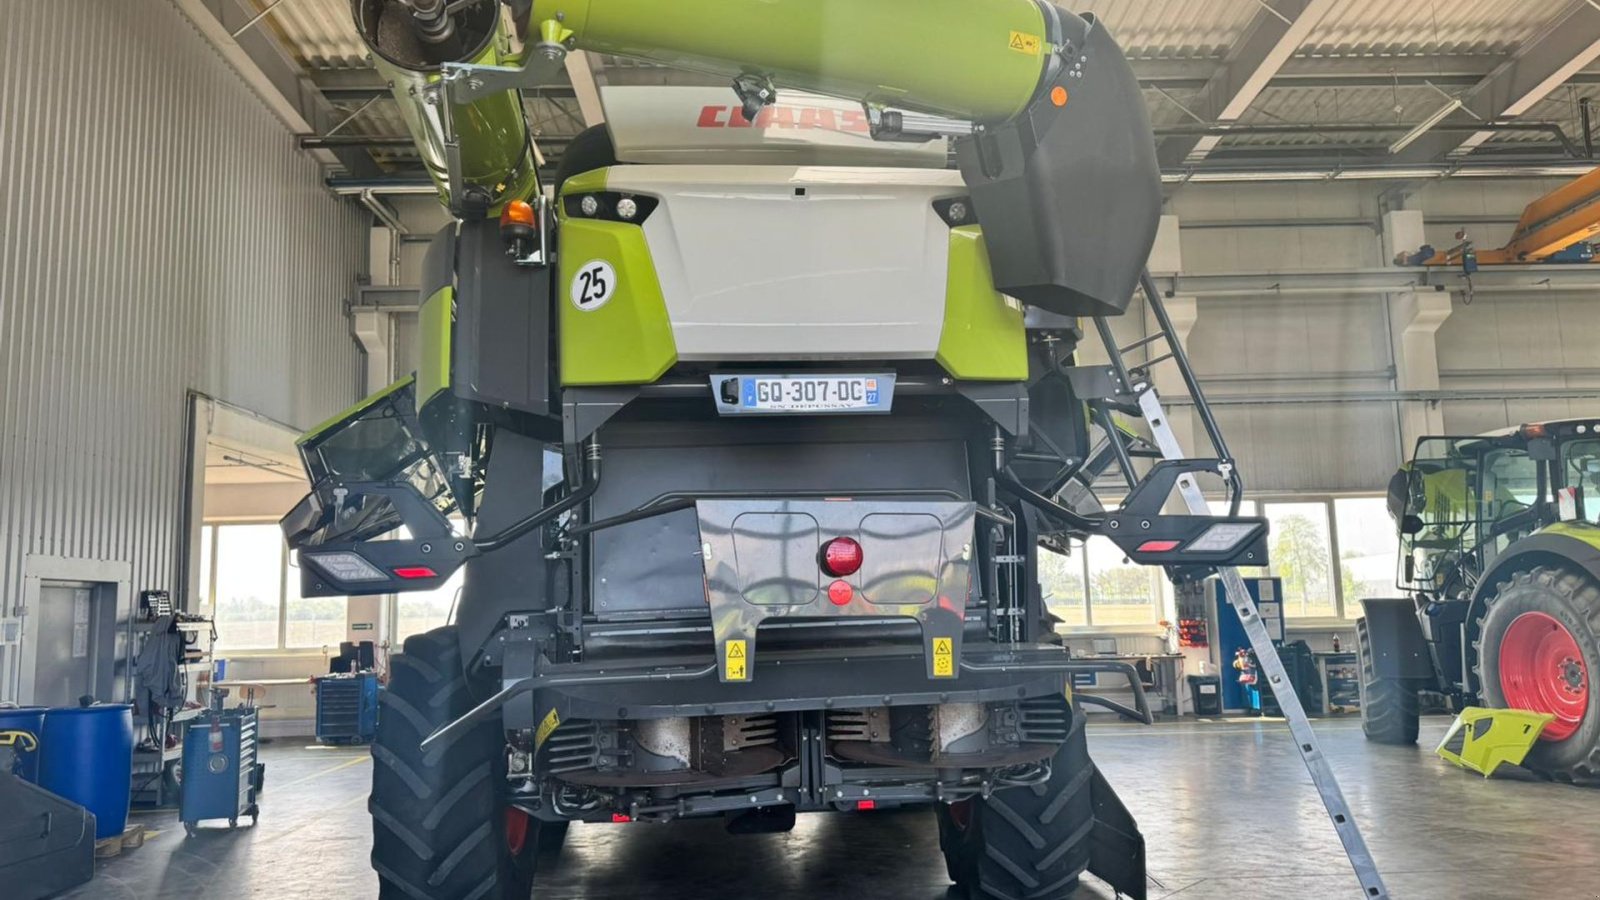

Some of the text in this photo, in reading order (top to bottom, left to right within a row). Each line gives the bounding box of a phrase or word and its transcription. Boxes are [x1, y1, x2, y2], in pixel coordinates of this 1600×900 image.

[698, 105, 870, 131] CLAAS
[580, 266, 606, 304] 25
[758, 381, 862, 402] GQ-307-DC
[867, 393, 877, 402] 27
